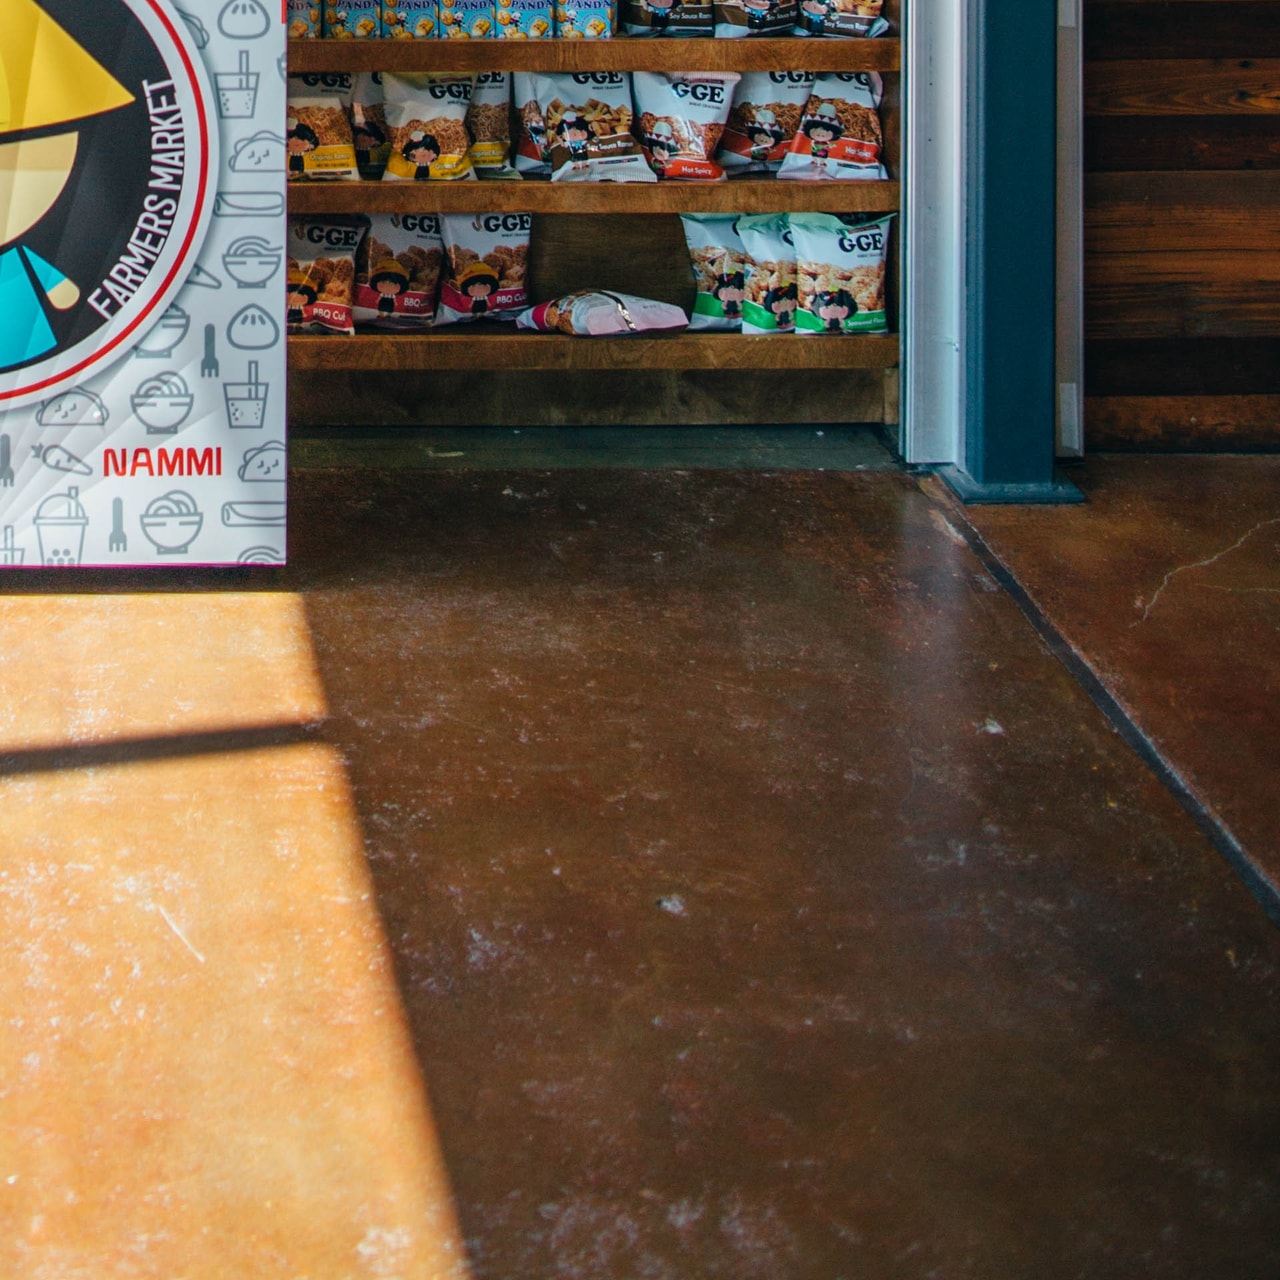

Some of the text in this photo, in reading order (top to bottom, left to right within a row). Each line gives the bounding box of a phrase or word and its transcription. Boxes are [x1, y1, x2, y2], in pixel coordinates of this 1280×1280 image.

[87, 78, 186, 323] FARMERS MARKET
[103, 447, 222, 477] NAMMI
